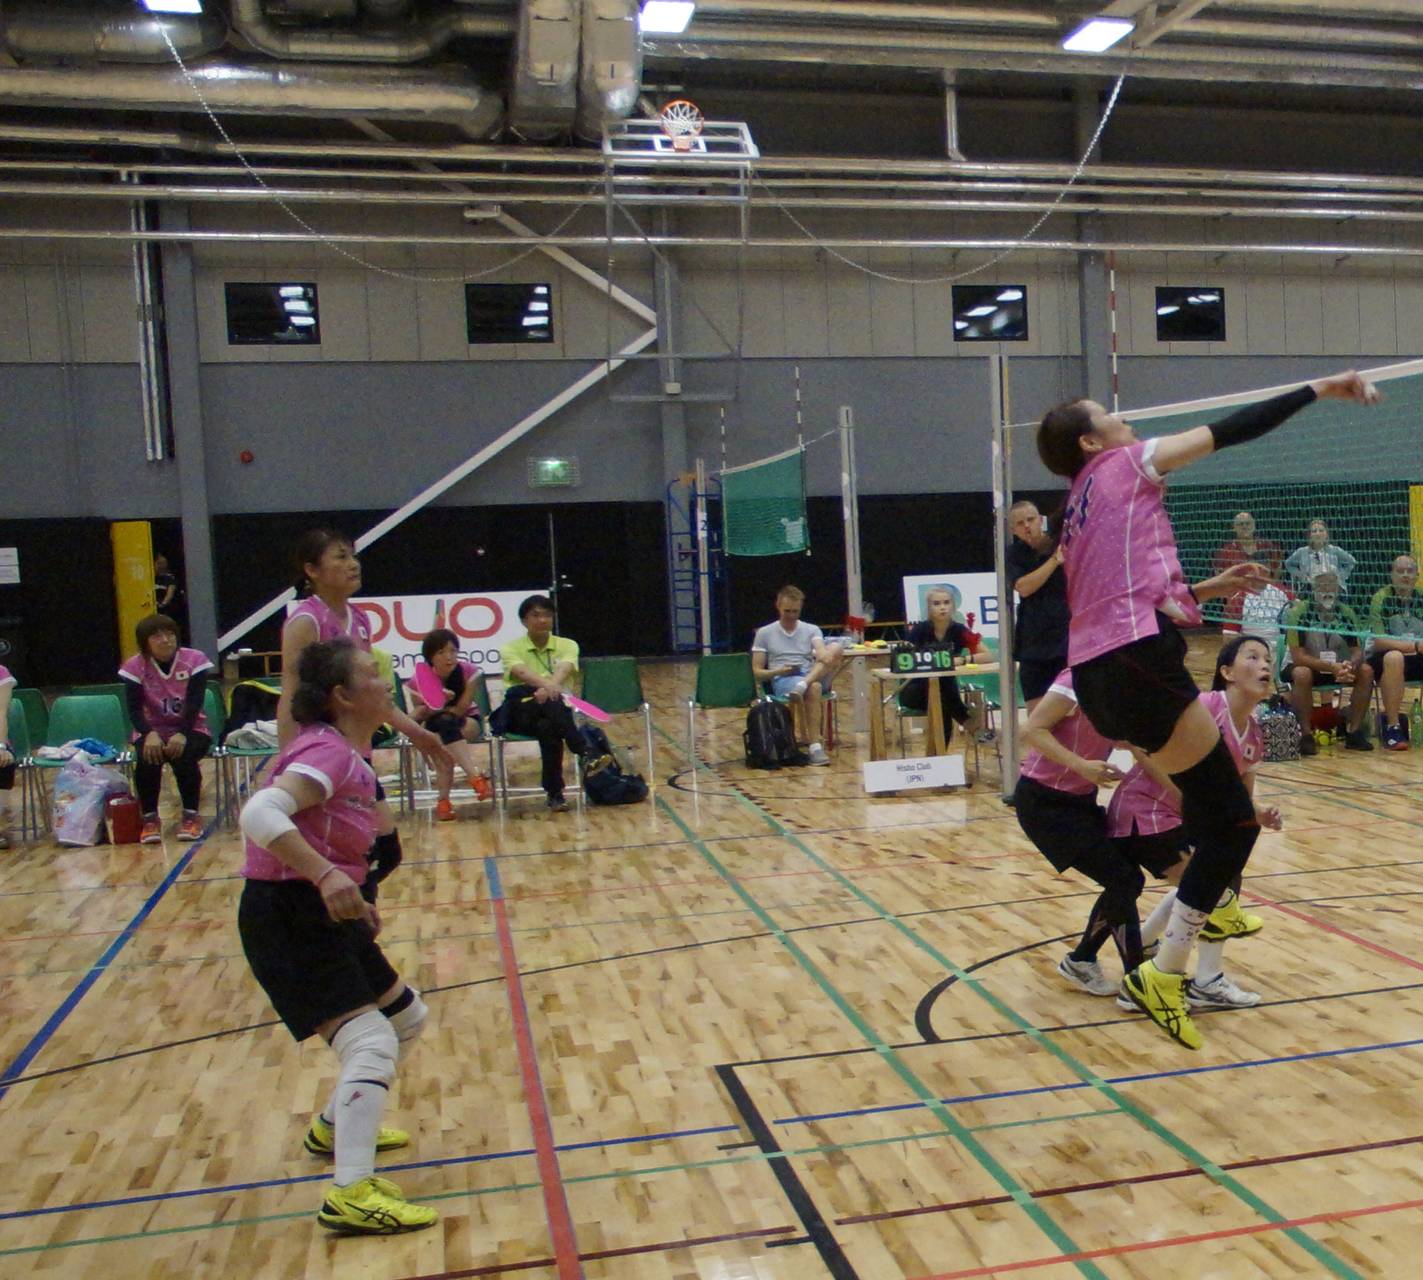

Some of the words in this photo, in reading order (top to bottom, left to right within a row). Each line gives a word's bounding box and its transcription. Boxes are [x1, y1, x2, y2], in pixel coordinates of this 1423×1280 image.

[896, 652, 915, 671] 9
[914, 650, 933, 663] 10
[932, 650, 952, 669] 16
